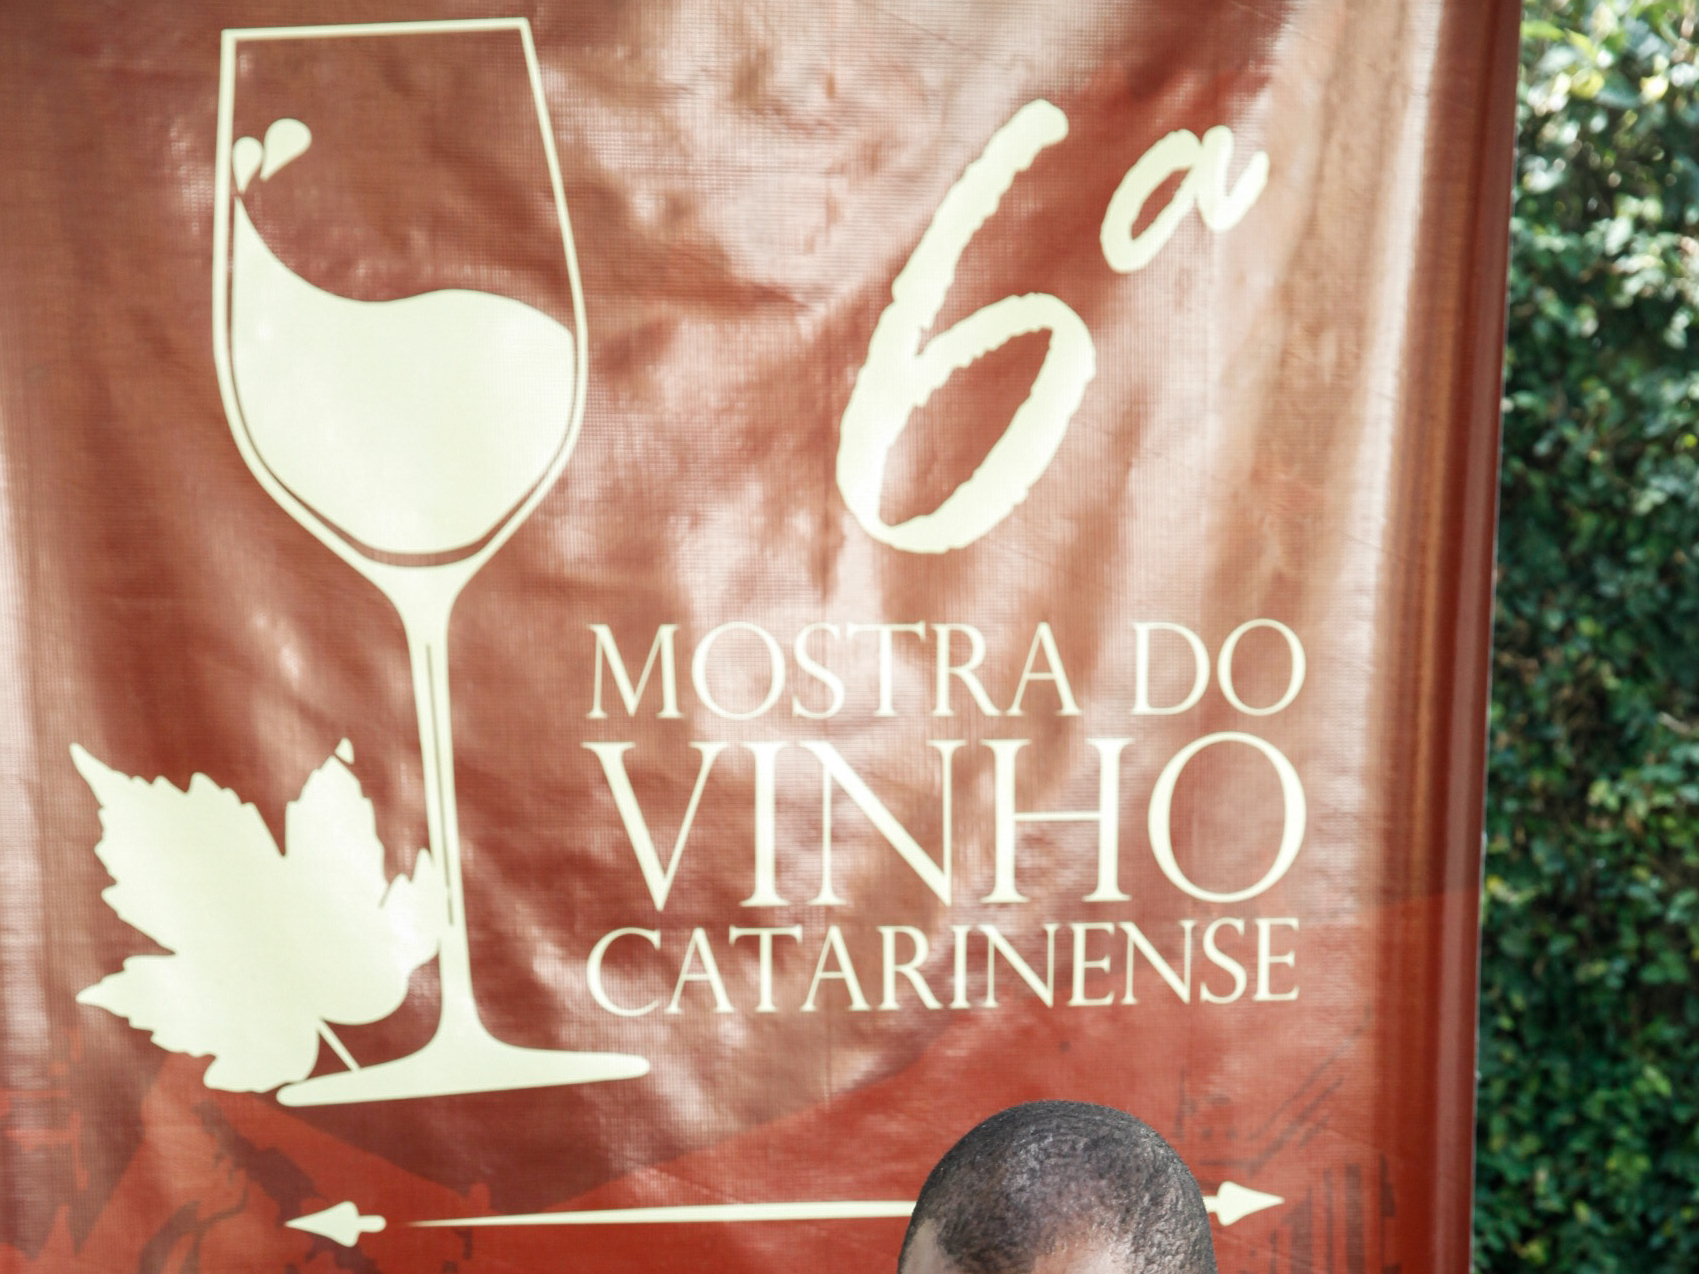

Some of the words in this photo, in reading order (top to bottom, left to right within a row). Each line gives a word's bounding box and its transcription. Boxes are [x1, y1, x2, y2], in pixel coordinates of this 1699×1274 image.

[586, 620, 1082, 721] MOSTRA
[1130, 618, 1307, 717] DO
[581, 730, 1307, 912] VINHO
[585, 916, 1301, 1017] CATARINENSE
